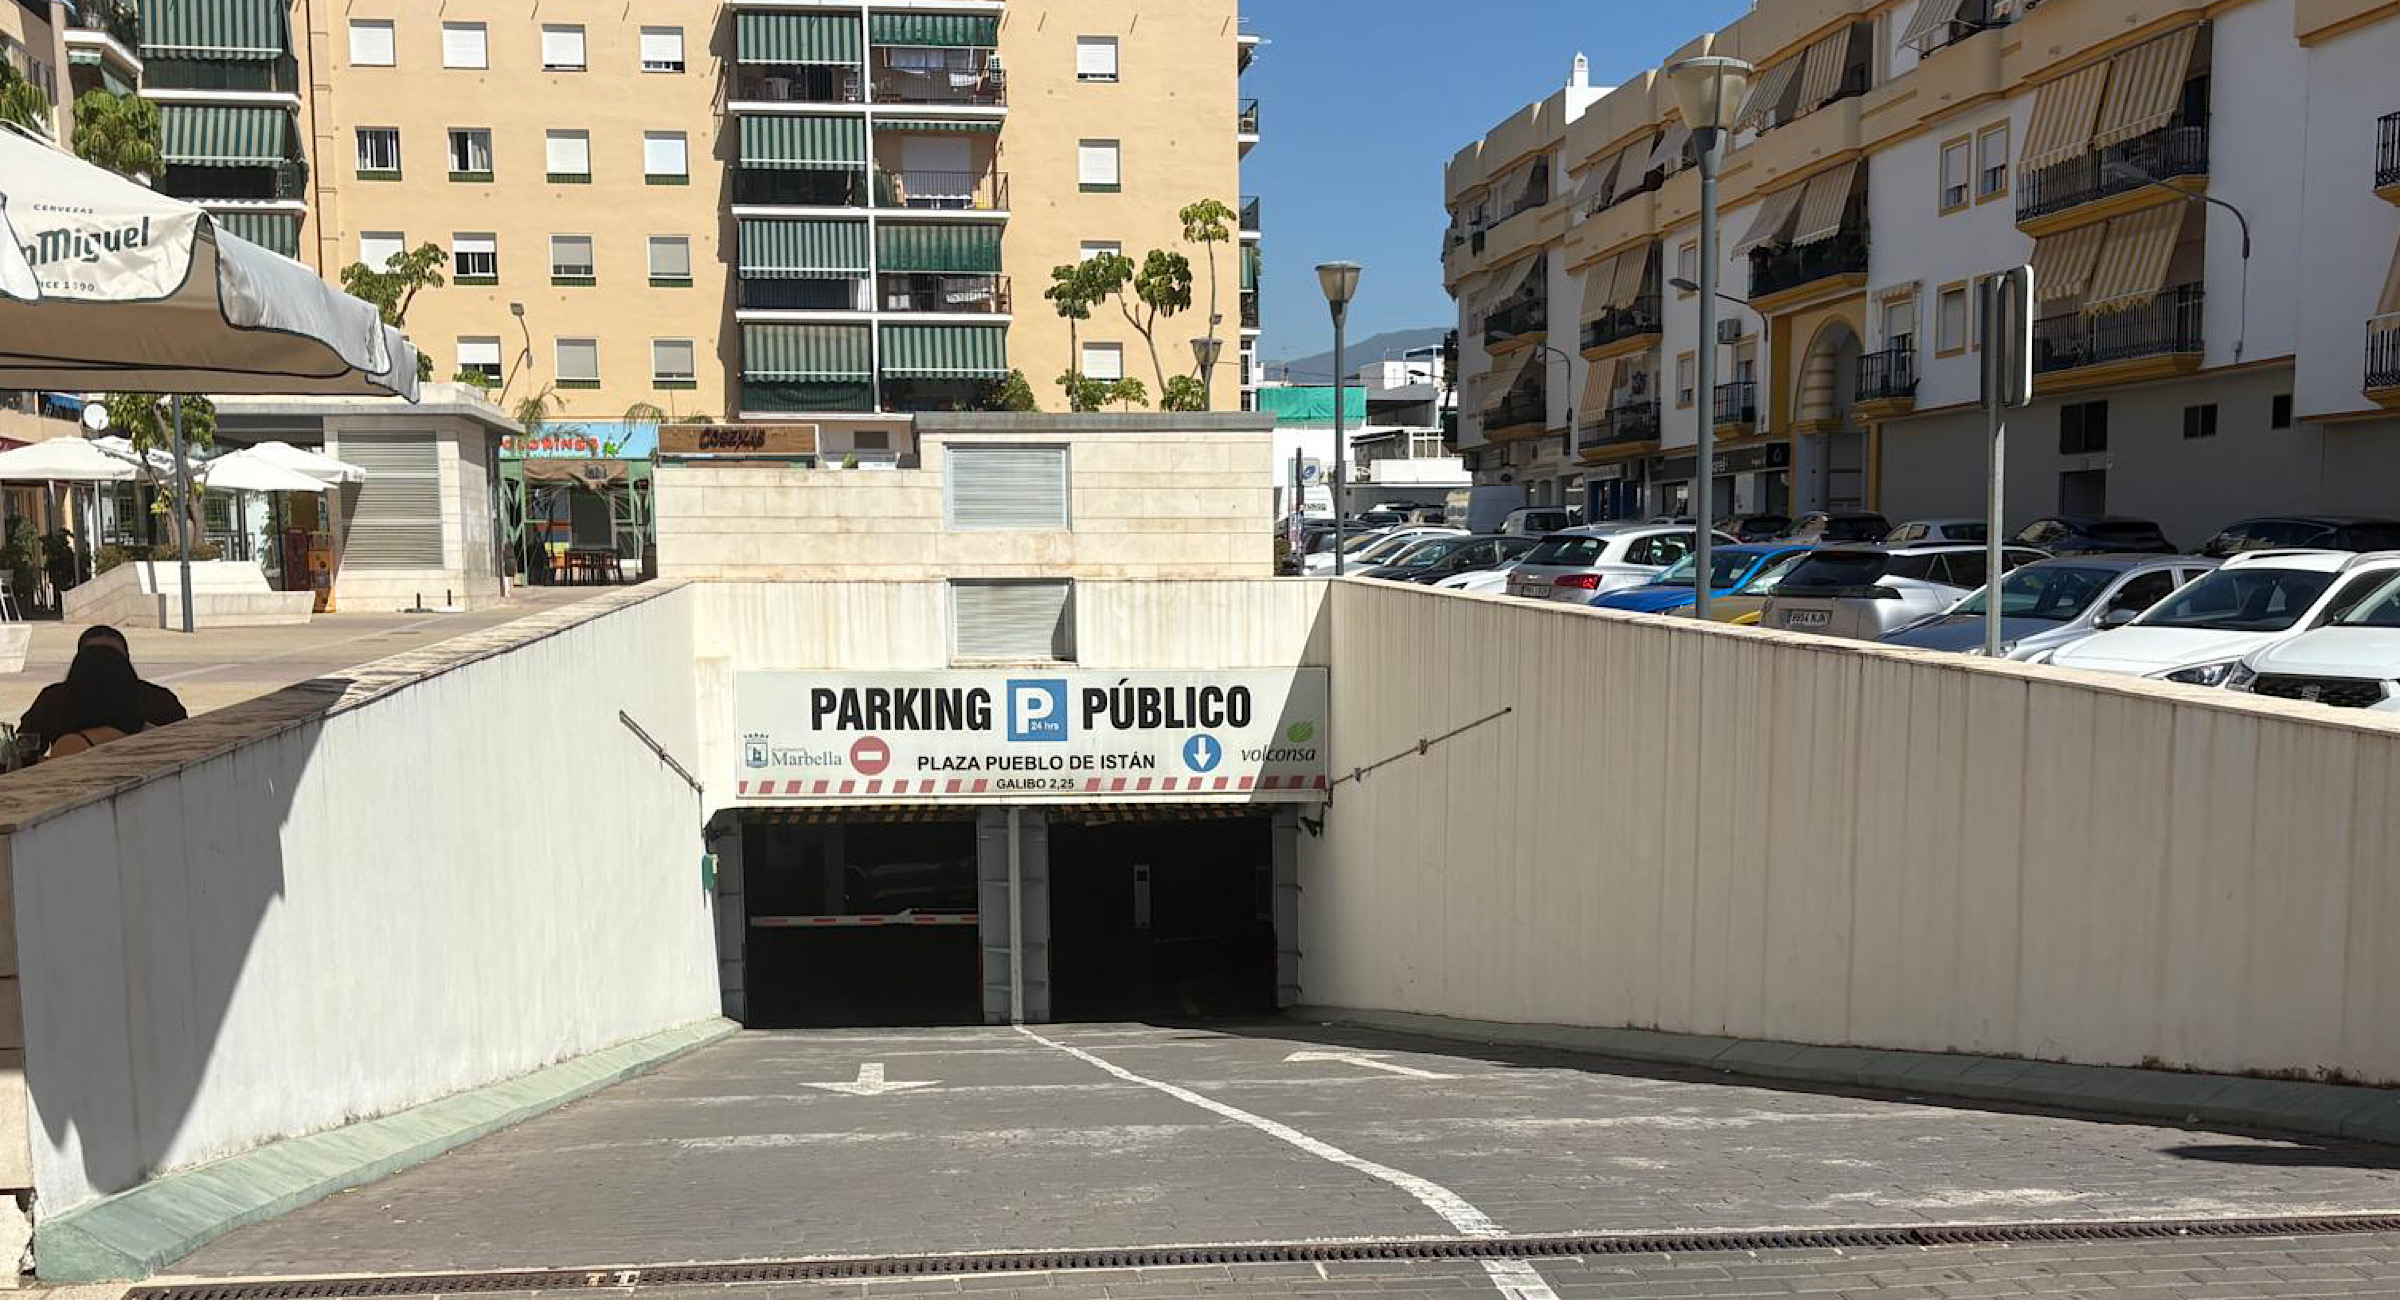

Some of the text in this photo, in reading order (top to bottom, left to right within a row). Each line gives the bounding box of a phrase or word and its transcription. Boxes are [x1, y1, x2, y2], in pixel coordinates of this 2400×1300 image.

[33, 203, 94, 215] CERVEZAS
[811, 678, 1252, 734] PARKING P PÚBLICO
[1030, 721, 1043, 731] 24
[771, 749, 842, 766] Marbella
[918, 752, 1156, 771] PLAZA PUEBLO DE ISTÁN
[1241, 745, 1316, 762] volconsa
[996, 778, 1075, 790] GALIBO 2,25
